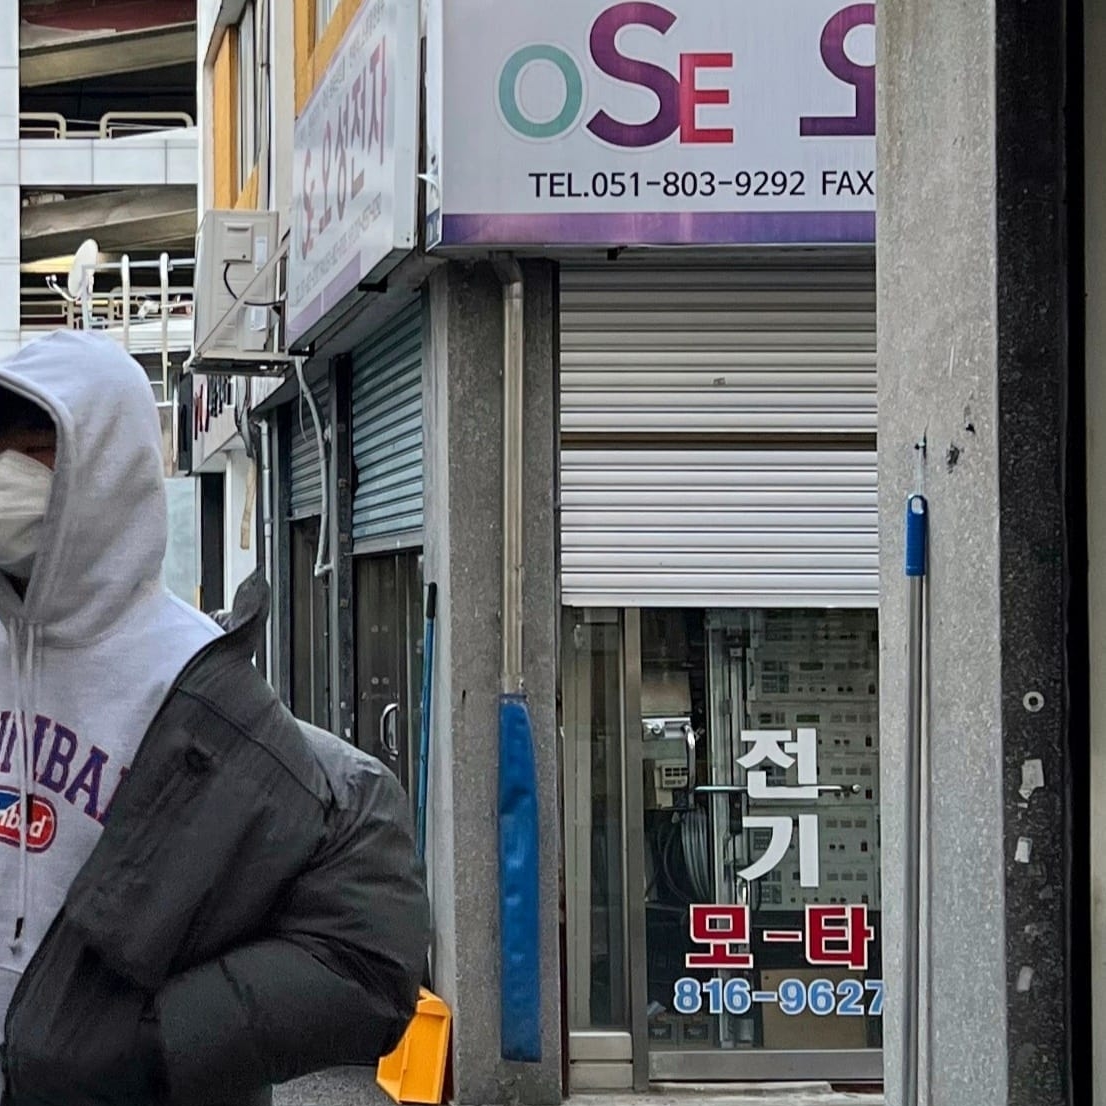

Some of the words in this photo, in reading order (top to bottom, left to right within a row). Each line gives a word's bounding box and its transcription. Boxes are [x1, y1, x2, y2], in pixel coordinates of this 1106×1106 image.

[499, 1, 734, 147] OSE
[319, 35, 387, 235] 오성전자
[528, 171, 805, 197] TEL.051-803-9292
[822, 171, 875, 196] FAX
[673, 976, 887, 1016] 816-9627
